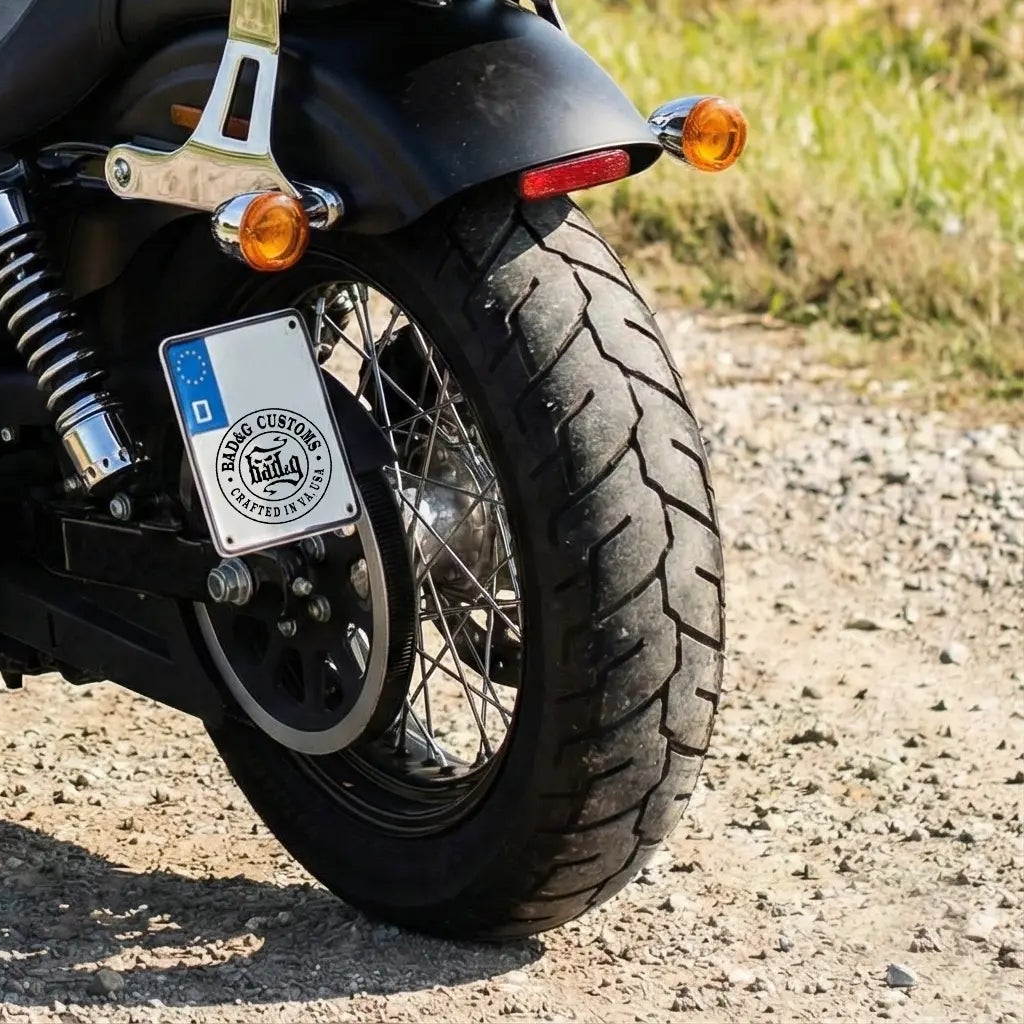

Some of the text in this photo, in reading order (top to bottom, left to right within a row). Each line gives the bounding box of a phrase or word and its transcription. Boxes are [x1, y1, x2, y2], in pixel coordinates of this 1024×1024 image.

[221, 413, 322, 472] BAD&G CUSTOMS
[230, 487, 281, 517] CRAFTED
[284, 502, 297, 516] IN
[309, 468, 325, 491] USA
